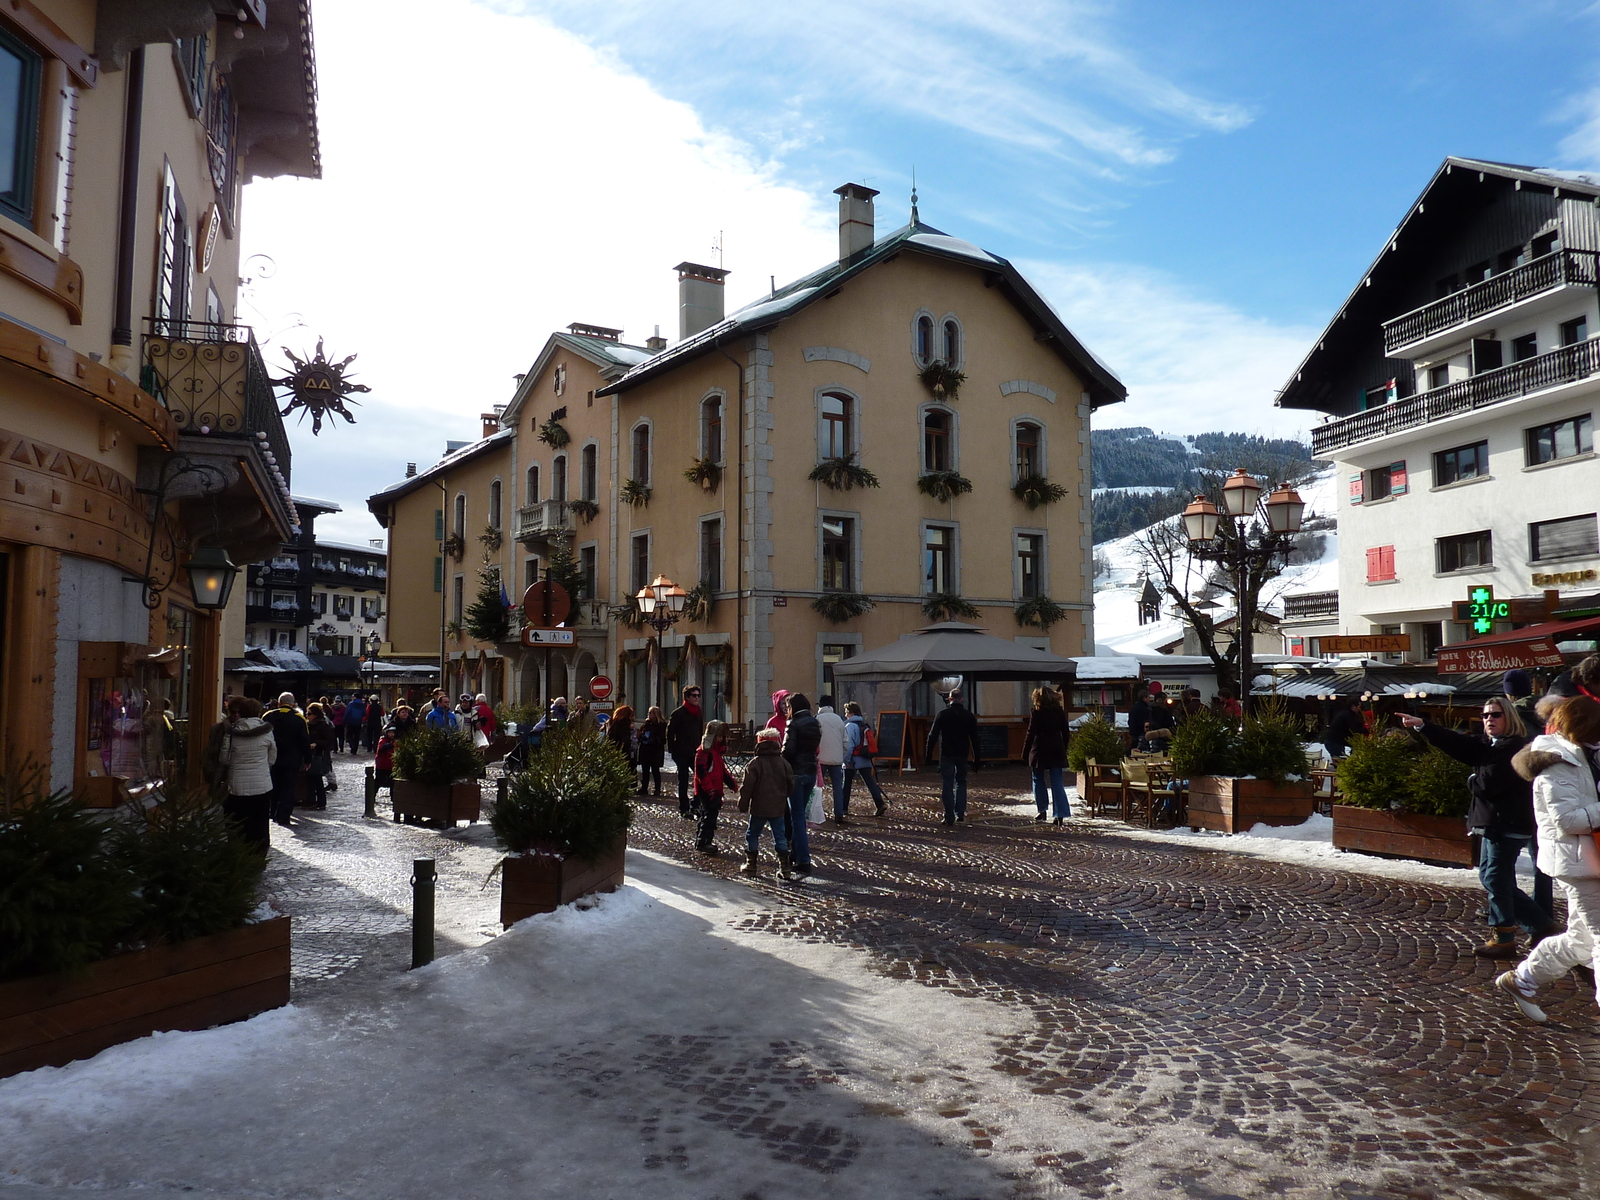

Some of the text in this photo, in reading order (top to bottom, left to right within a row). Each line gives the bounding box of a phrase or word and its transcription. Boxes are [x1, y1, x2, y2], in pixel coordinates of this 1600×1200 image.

[1531, 569, 1597, 586] Banque
[1328, 637, 1401, 650] LE CINTRA
